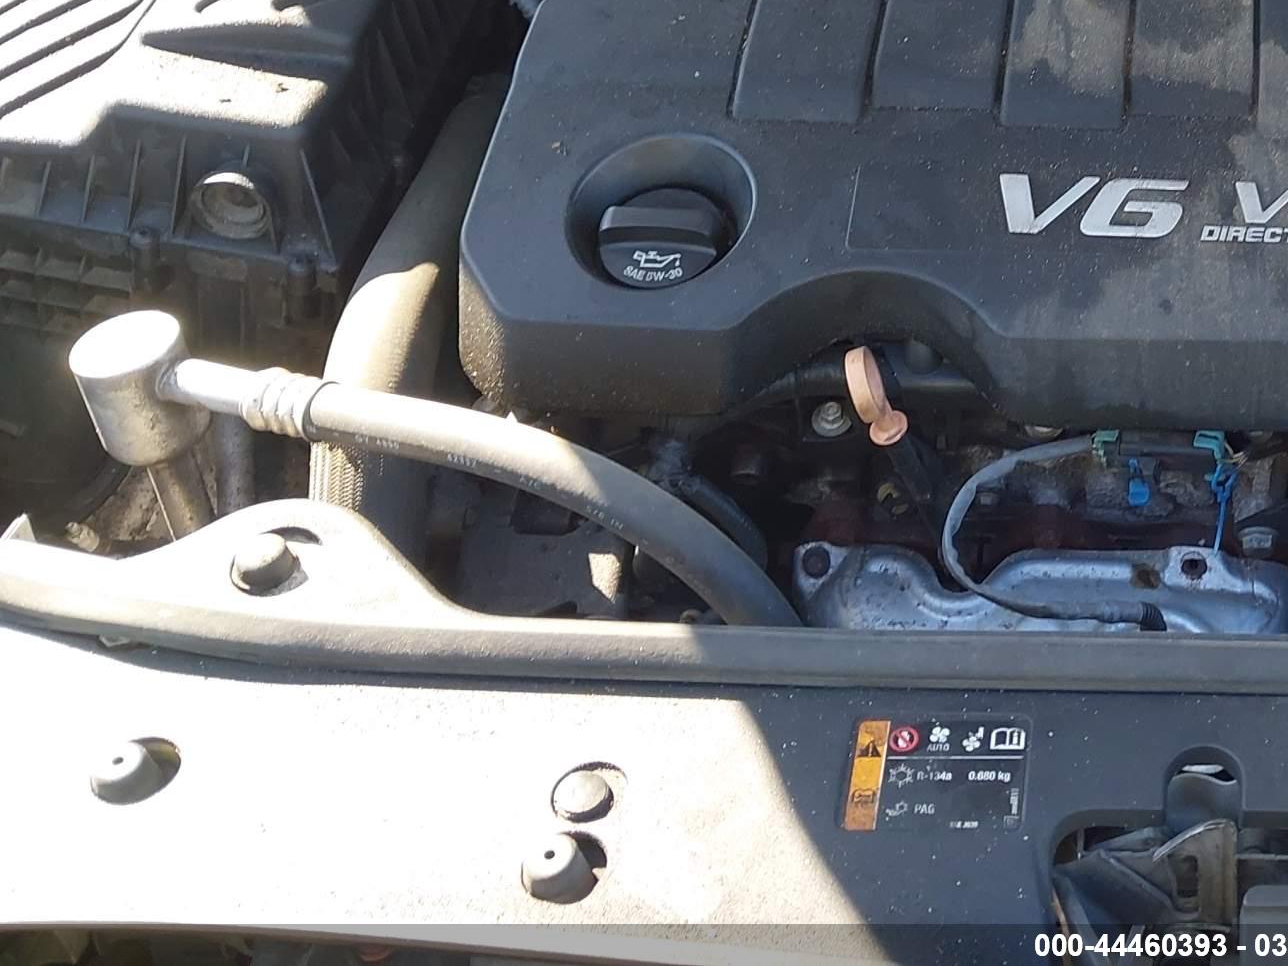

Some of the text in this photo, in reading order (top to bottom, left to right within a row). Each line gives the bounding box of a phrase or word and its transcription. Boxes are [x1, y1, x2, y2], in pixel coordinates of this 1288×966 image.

[1000, 173, 1190, 238] V6
[624, 265, 646, 281] SAE
[927, 743, 950, 752] AUTO
[997, 770, 1011, 783] kg
[913, 804, 935, 815] PAG
